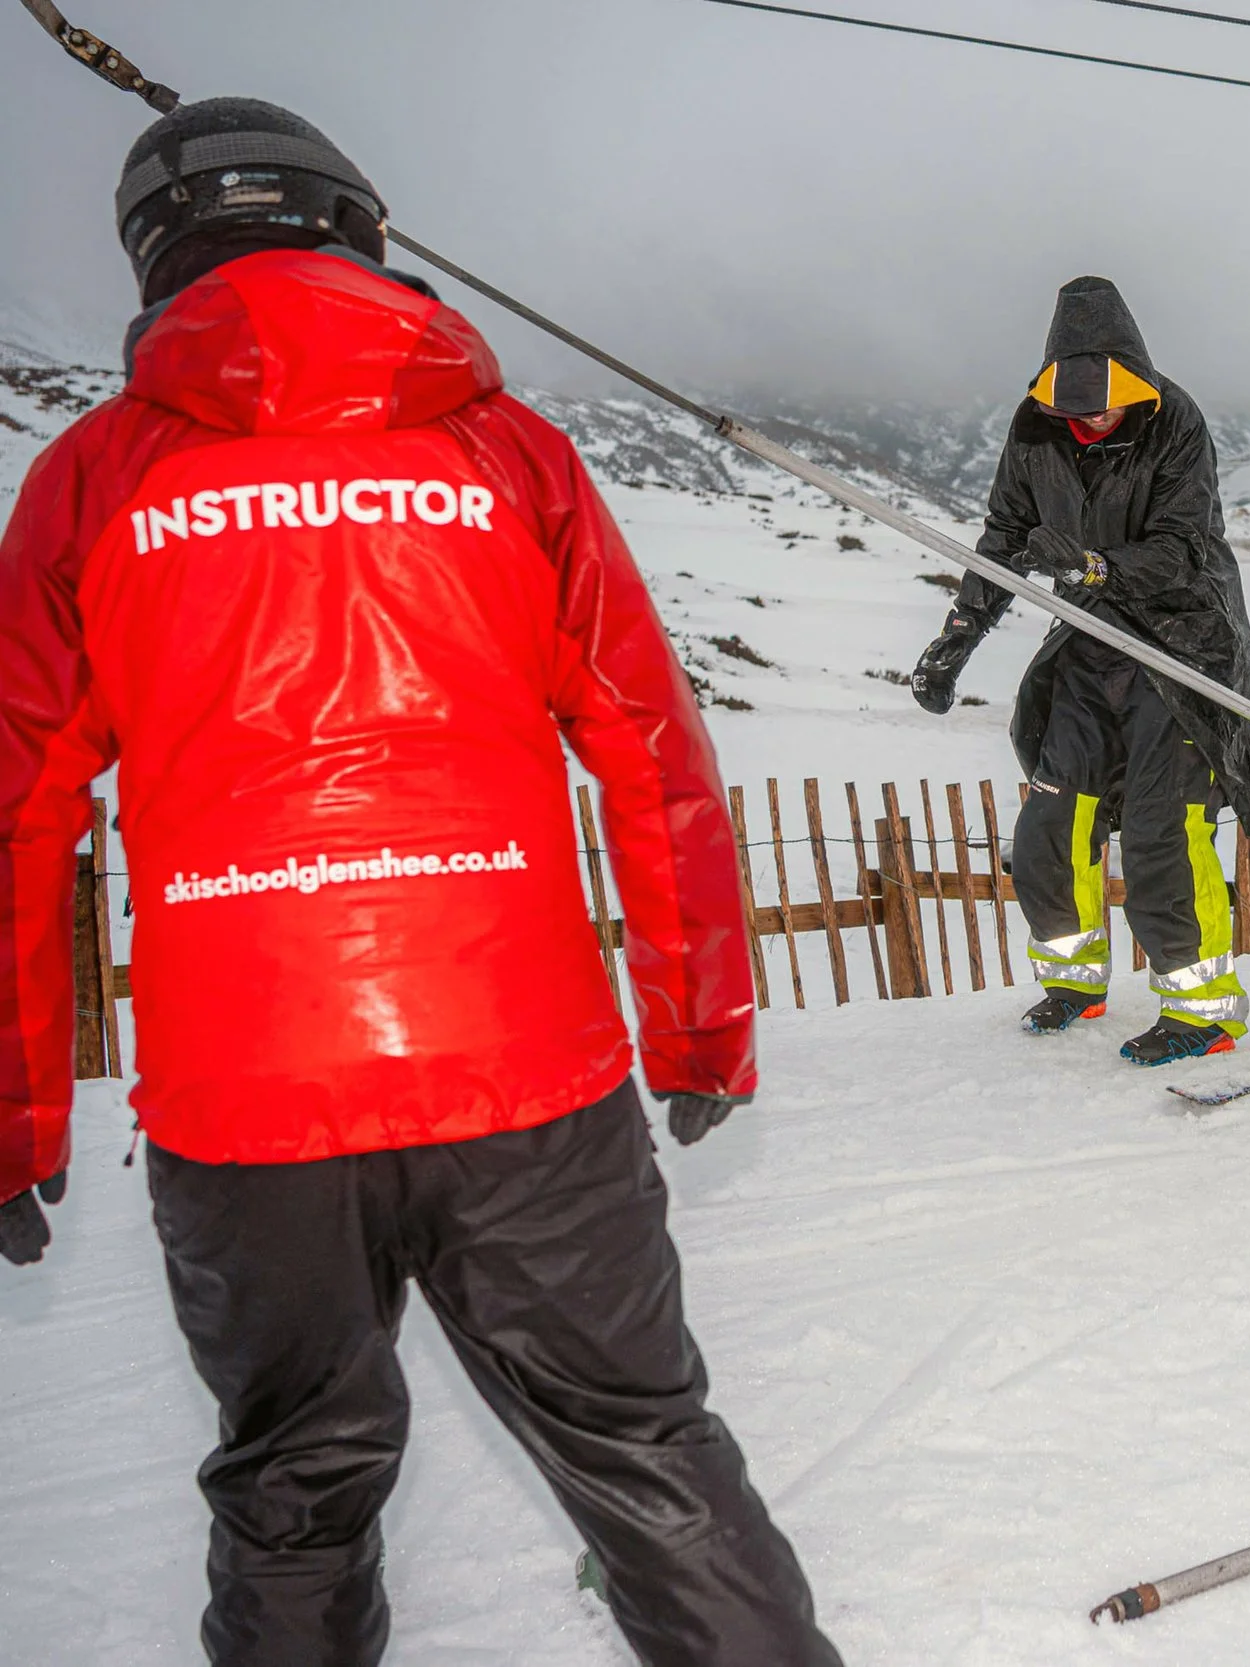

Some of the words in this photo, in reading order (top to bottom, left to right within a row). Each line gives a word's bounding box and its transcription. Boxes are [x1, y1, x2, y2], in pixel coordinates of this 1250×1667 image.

[131, 478, 495, 555] INSTRUCTOR
[1036, 780, 1061, 795] HANSEN
[164, 840, 528, 904] skischoolglenshee.co.uk
